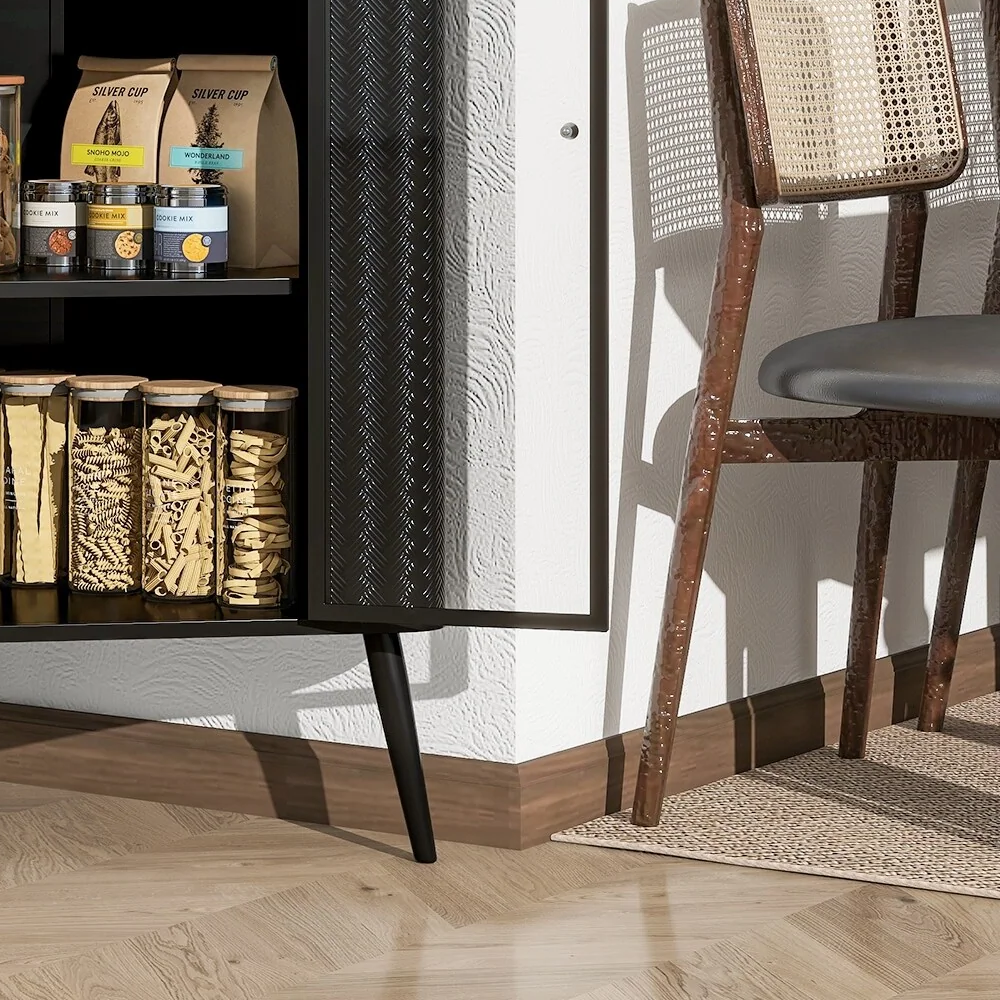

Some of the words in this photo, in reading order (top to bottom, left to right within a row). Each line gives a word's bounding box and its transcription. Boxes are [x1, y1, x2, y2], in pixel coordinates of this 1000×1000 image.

[92, 86, 126, 97] SILVER
[127, 87, 149, 97] CUP
[191, 88, 226, 99] SILVER
[227, 89, 249, 100] CUP
[184, 152, 230, 160] WONDERLAND
